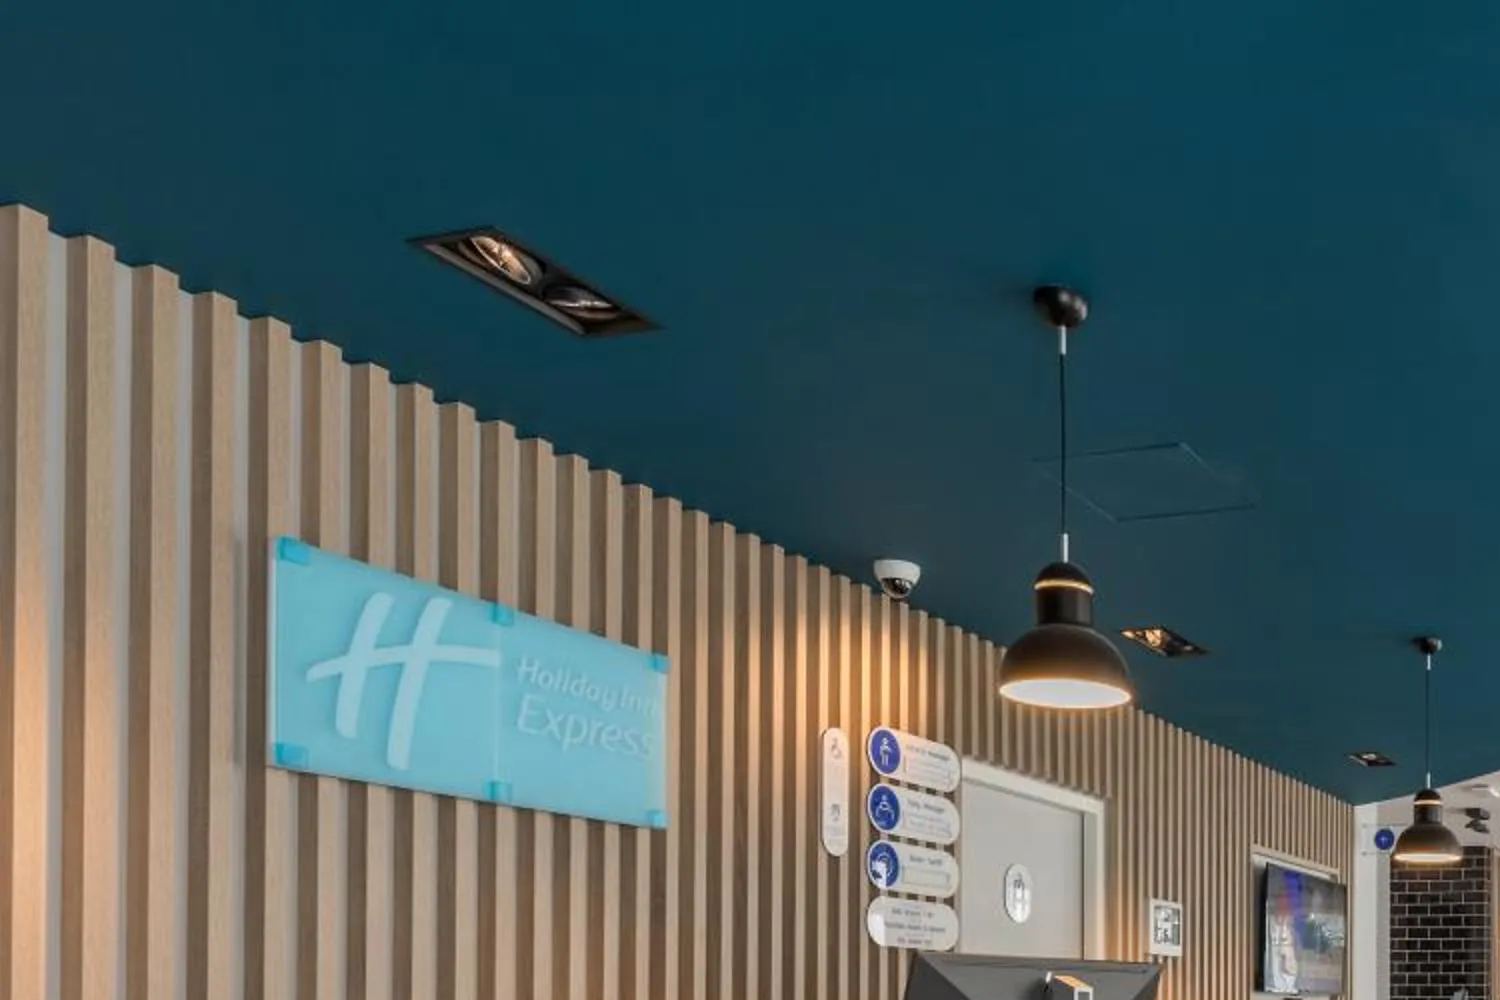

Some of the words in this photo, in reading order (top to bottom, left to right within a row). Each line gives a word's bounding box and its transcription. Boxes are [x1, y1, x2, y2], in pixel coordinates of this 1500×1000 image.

[516, 655, 619, 712] Holiday
[619, 684, 658, 718] Inn
[516, 693, 655, 760] Express
